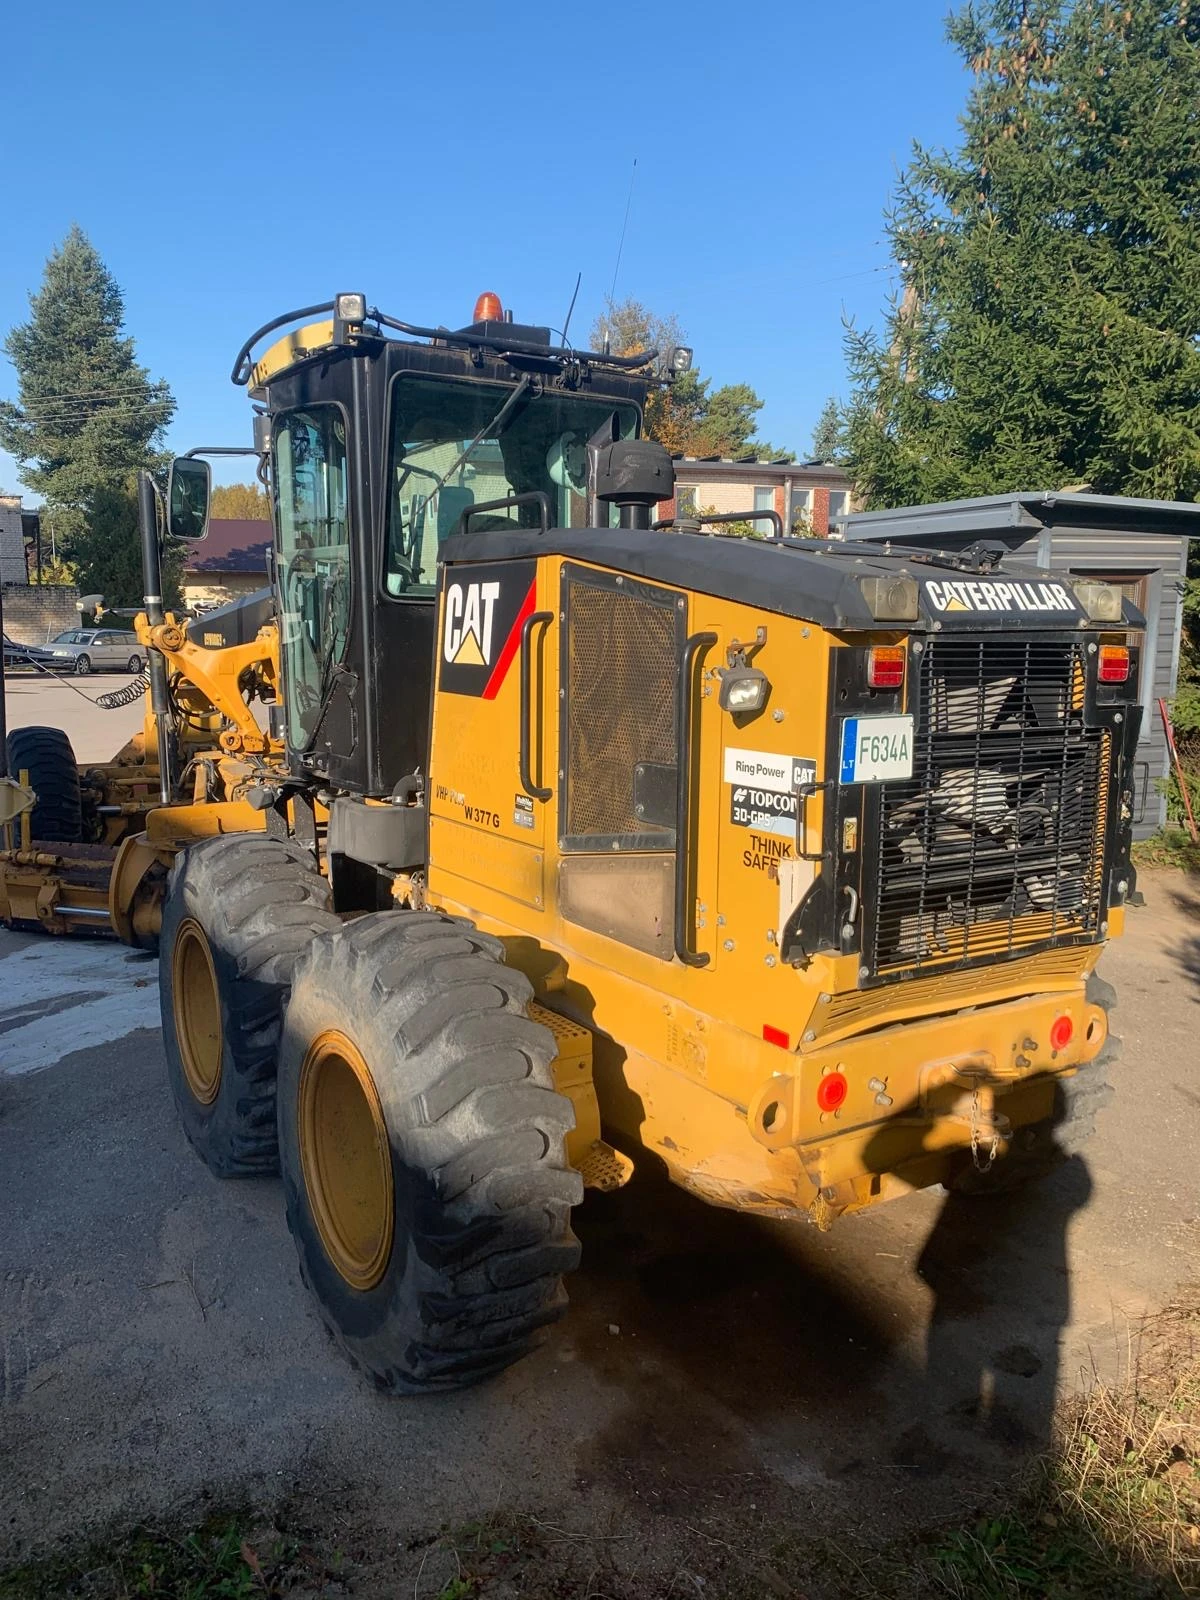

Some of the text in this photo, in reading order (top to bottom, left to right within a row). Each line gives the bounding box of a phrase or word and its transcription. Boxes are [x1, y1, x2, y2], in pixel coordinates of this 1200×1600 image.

[925, 580, 1077, 611] CATERPILLAR
[444, 582, 500, 666] CAT
[859, 734, 908, 765] F634A
[735, 760, 785, 779] Ring Power
[793, 766, 815, 784] CAT
[842, 759, 854, 769] LT
[733, 806, 772, 827] 3D-GPS
[749, 834, 792, 858] THINK
